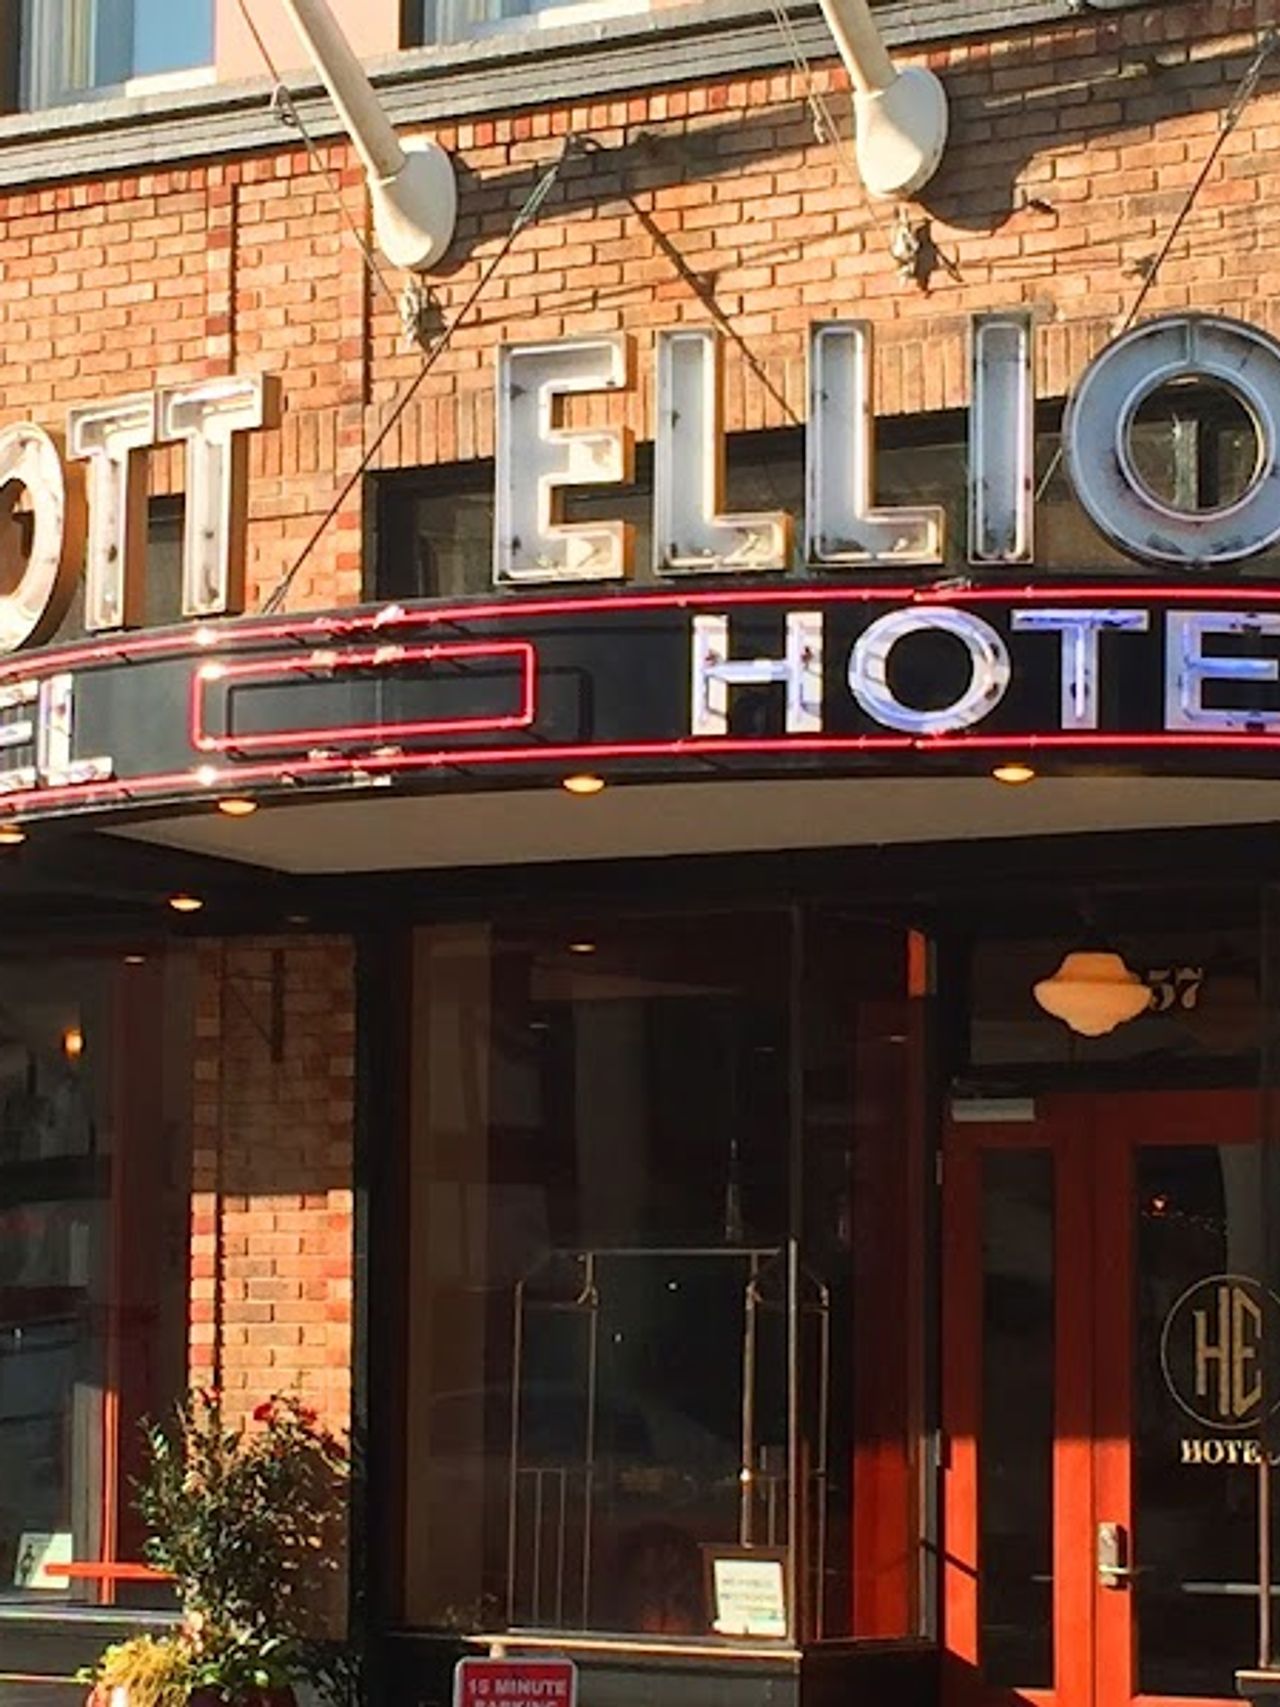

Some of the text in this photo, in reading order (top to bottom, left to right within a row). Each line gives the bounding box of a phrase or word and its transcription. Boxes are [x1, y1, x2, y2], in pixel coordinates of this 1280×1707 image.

[494, 312, 1280, 585] ELLIO
[691, 606, 1280, 736] HOTE
[468, 1679, 567, 1697] 15 MINUTE
